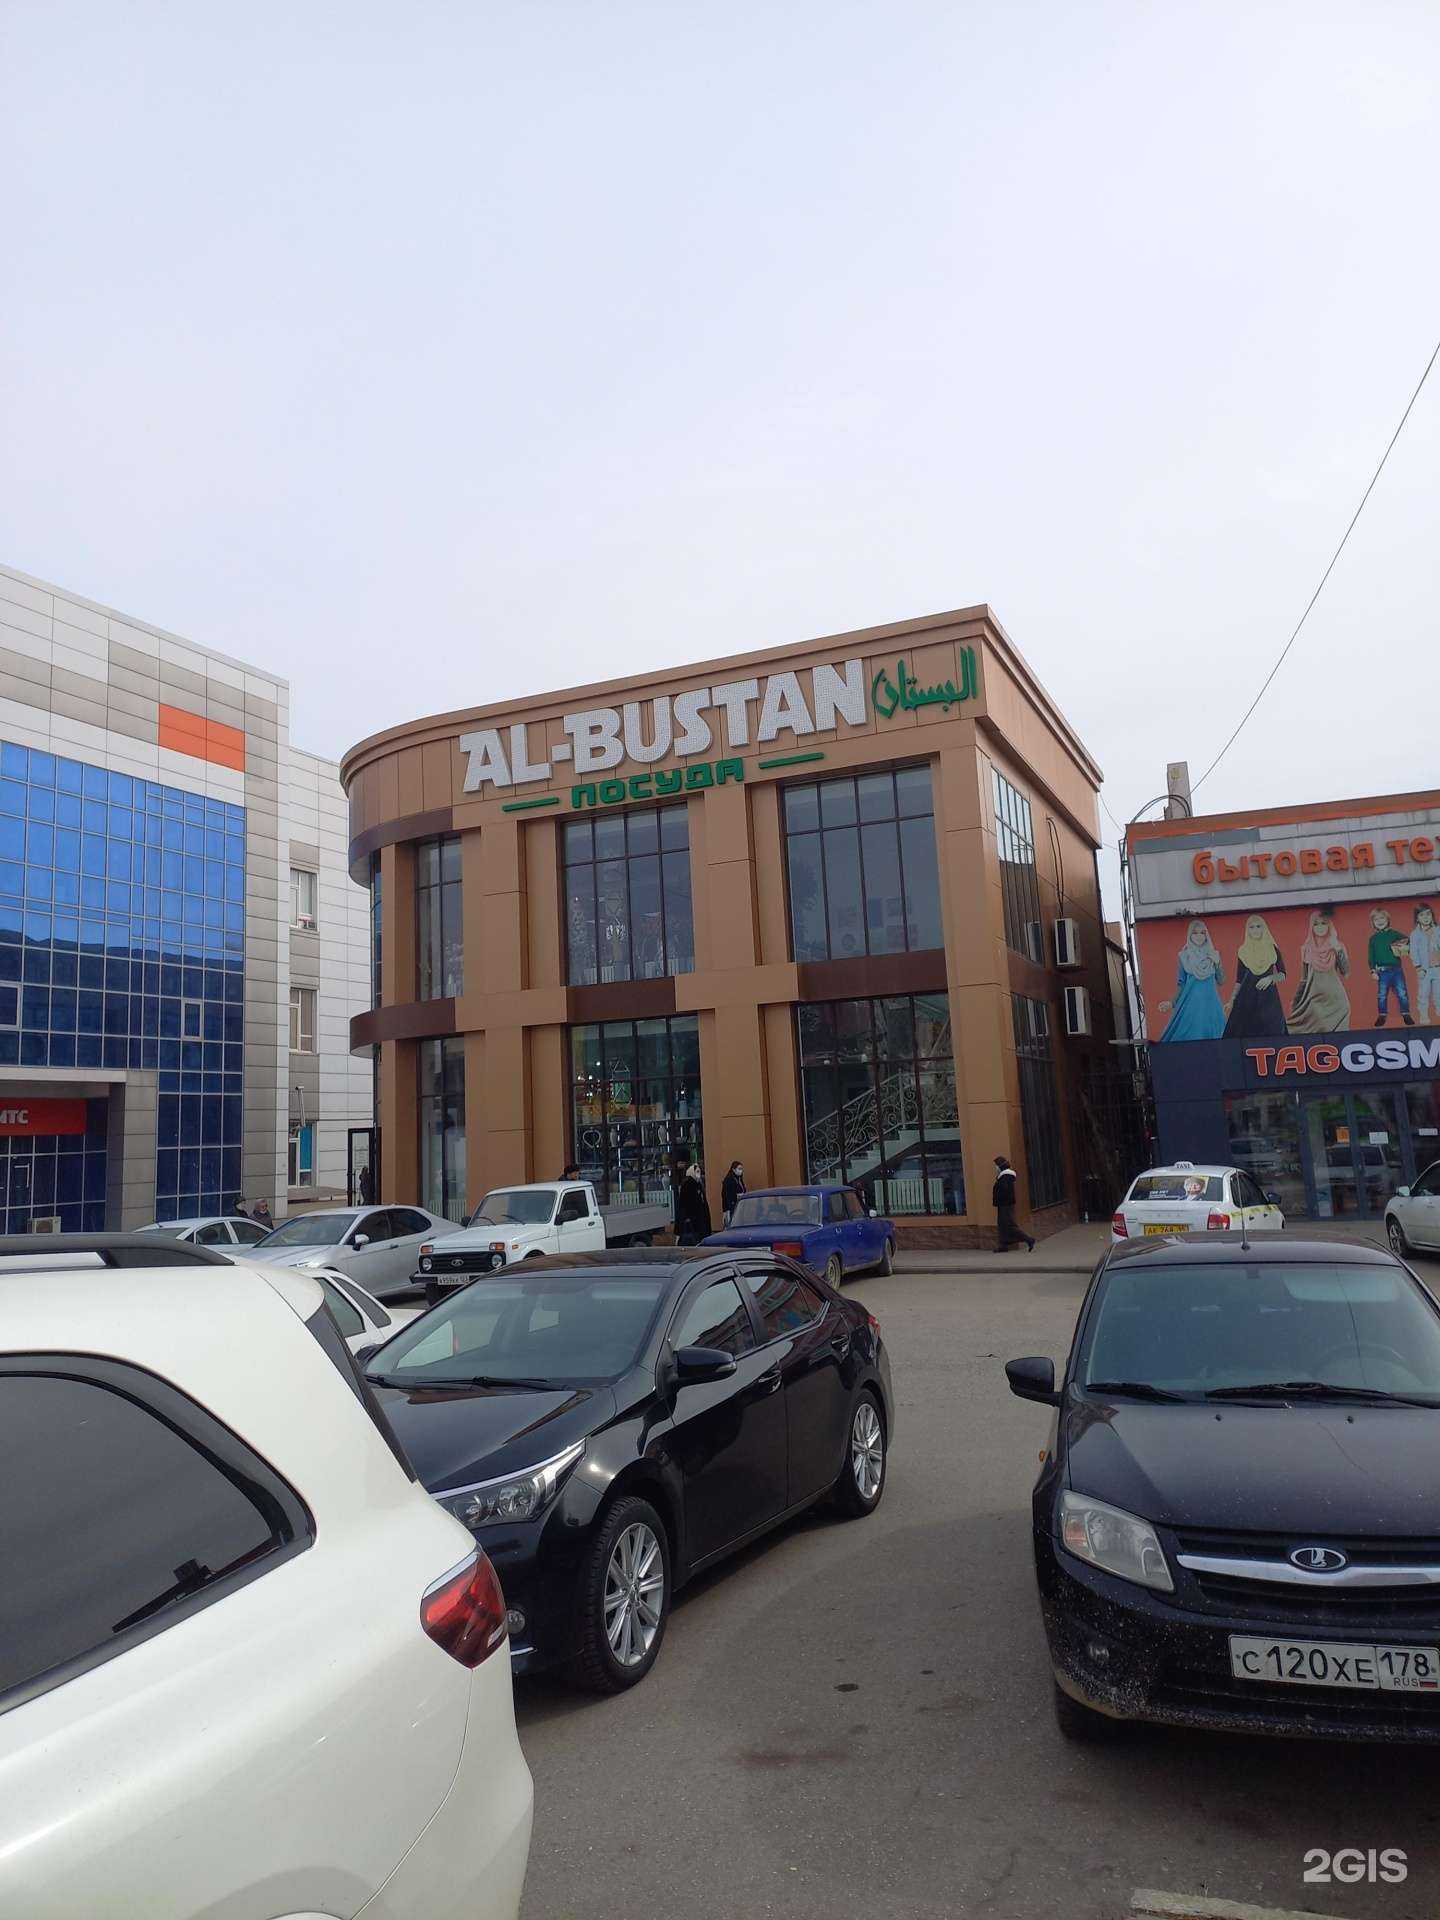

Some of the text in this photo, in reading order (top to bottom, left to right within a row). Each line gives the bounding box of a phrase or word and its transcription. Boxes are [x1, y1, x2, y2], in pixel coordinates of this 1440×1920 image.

[872, 646, 977, 719] البستان
[459, 658, 868, 794] AL-BUSTAN
[1192, 835, 1440, 885] бытовая те
[1380, 1651, 1430, 1677] 178
[1394, 1677, 1420, 1687] RUS
